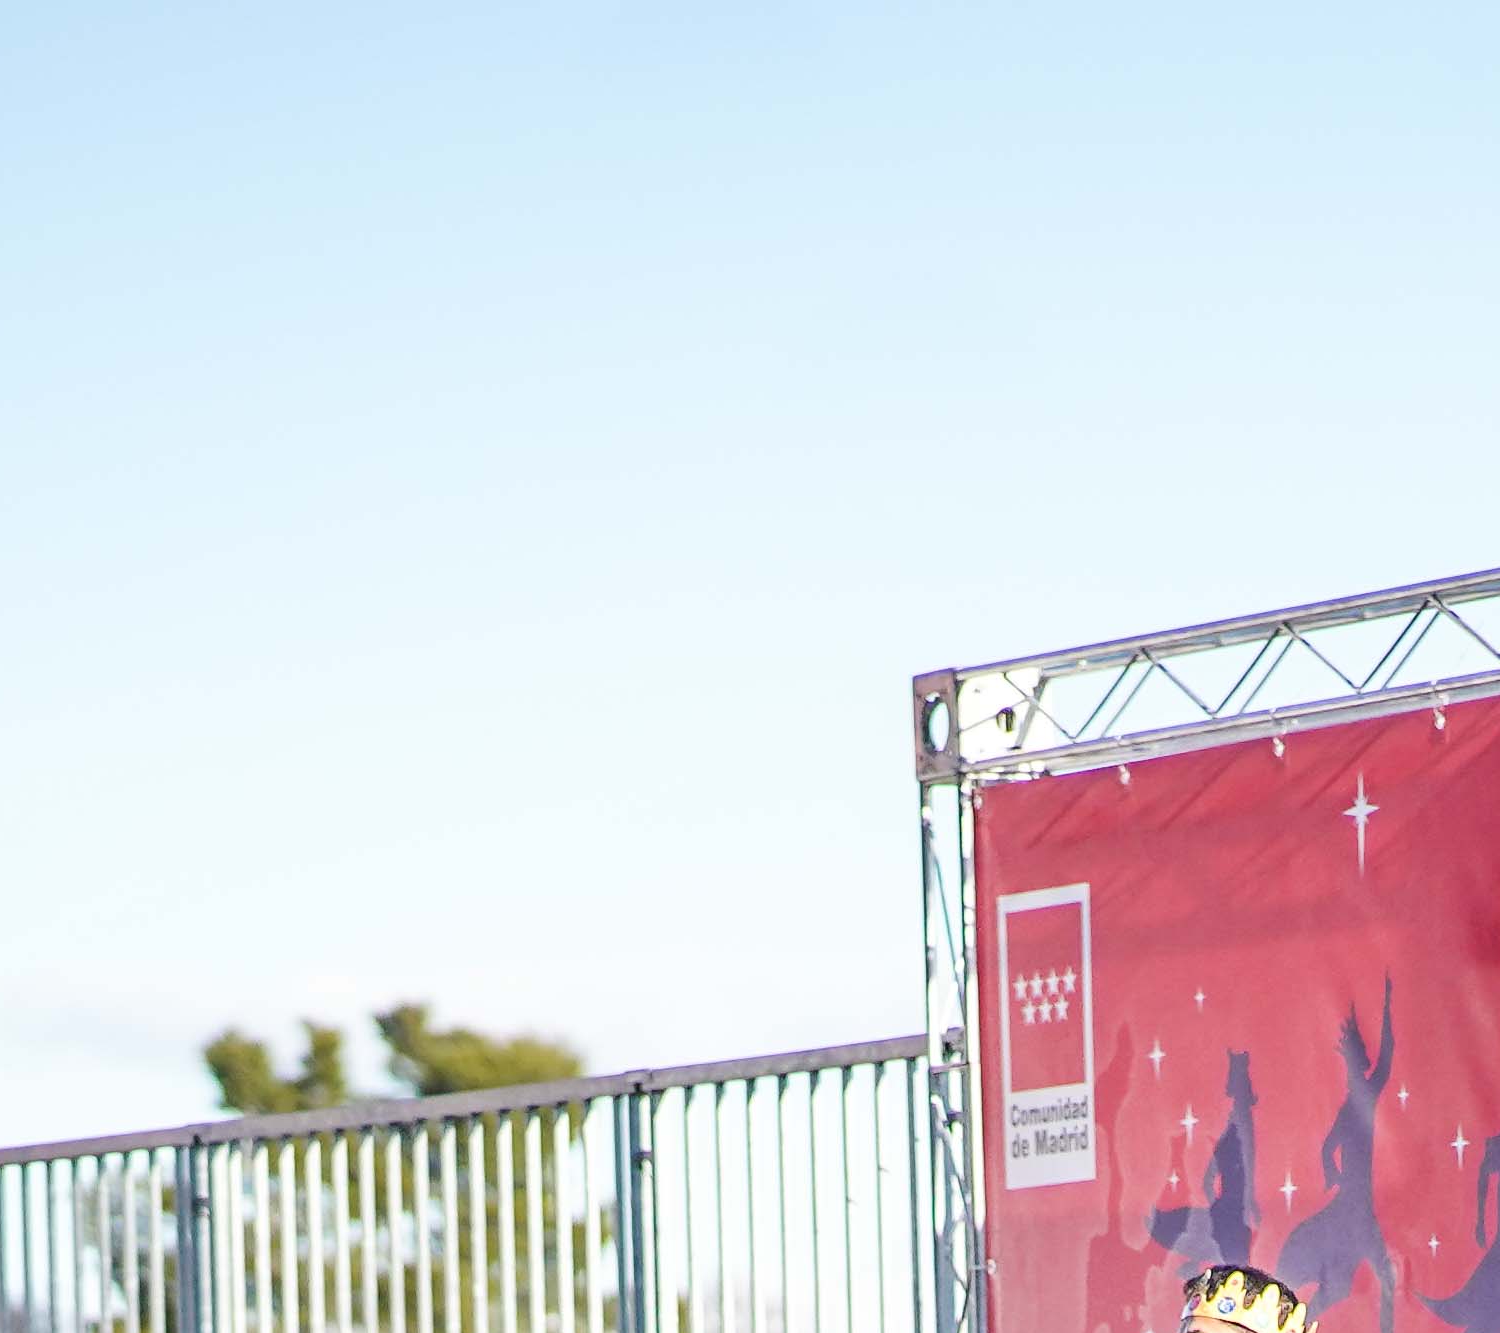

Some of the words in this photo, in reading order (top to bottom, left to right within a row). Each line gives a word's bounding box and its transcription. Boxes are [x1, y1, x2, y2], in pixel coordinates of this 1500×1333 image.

[1011, 1094, 1089, 1129] Comunidad
[1011, 1132, 1030, 1159] de
[1034, 1123, 1089, 1157] Madrid
